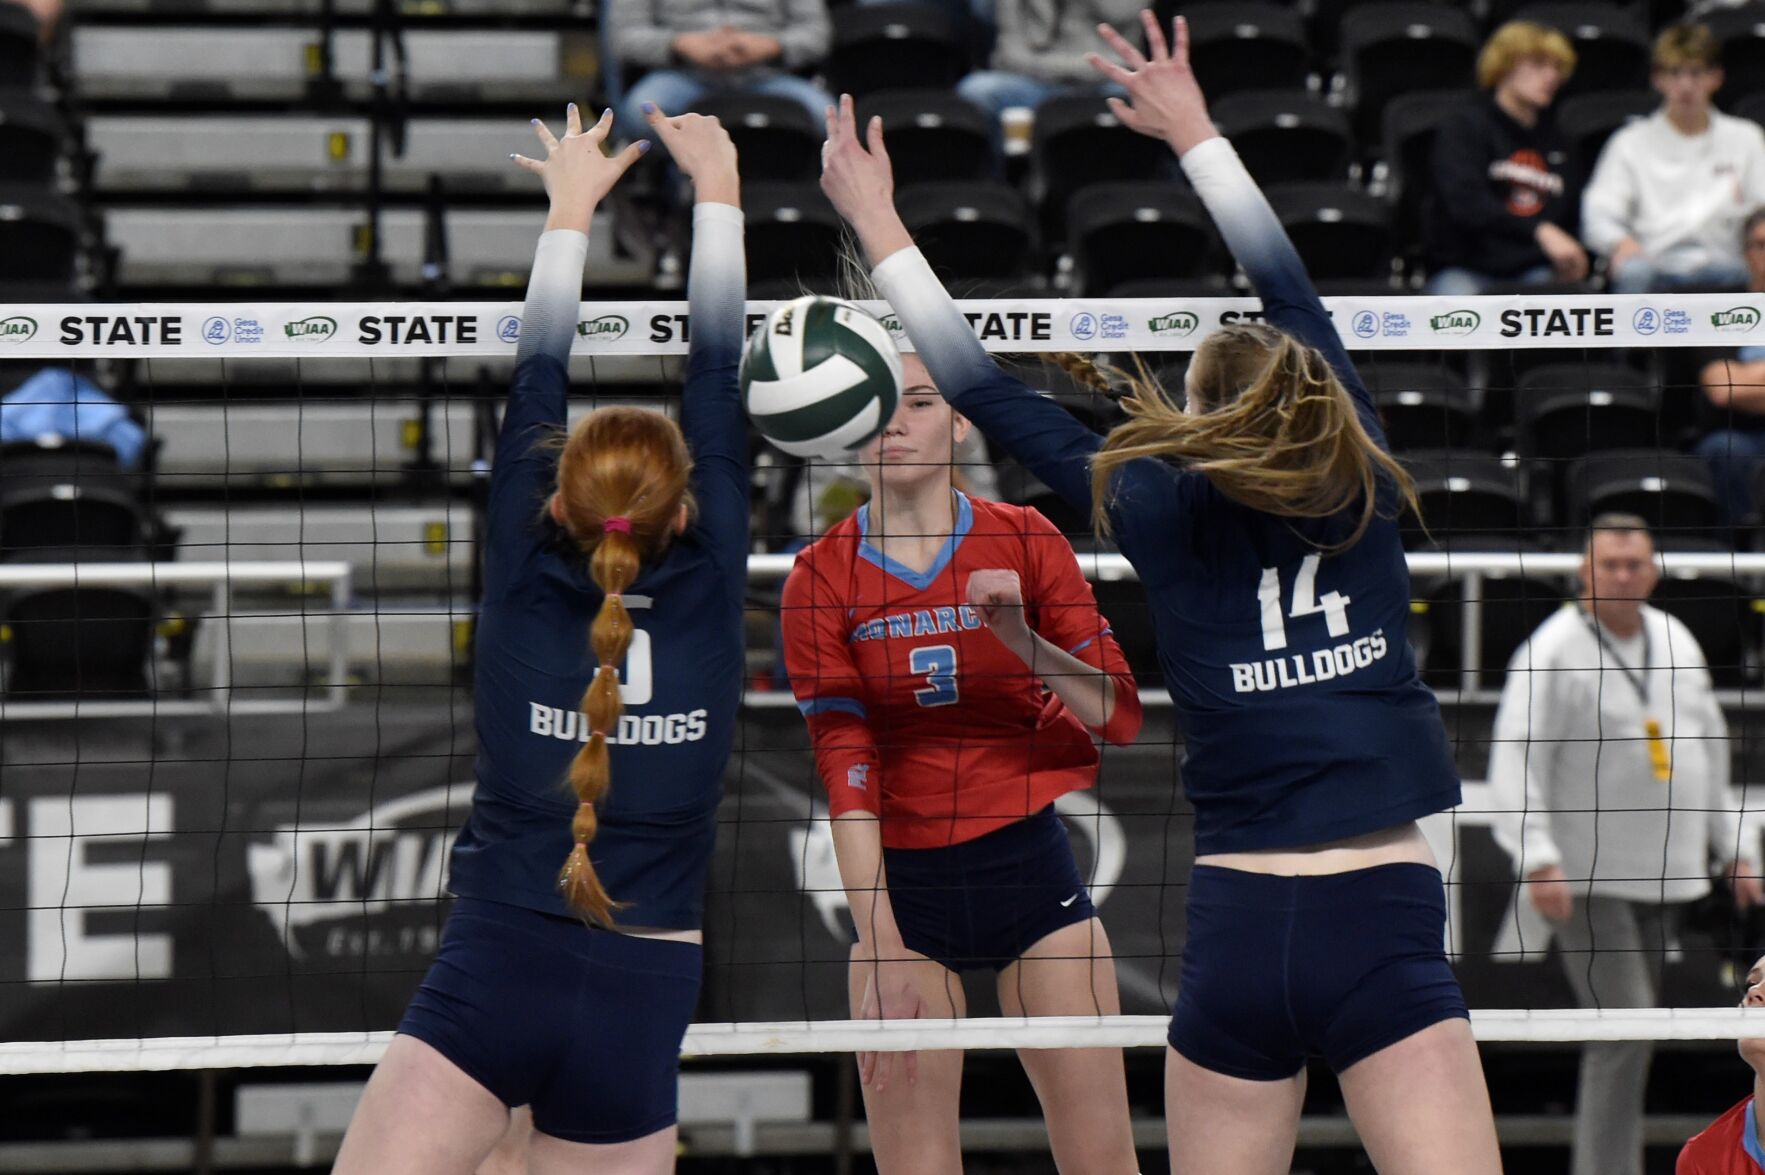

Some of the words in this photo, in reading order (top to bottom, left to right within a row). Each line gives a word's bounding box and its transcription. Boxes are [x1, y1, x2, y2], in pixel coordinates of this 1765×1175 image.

[1155, 318, 1192, 330] WIAA
[1382, 320, 1412, 329] Credit
[1436, 316, 1473, 328] WIAA
[1500, 308, 1615, 337] STATE
[1663, 317, 1693, 326] Credit
[1717, 312, 1754, 325] WIAA
[60, 316, 182, 345] STATE
[234, 326, 265, 335] Credit
[293, 322, 329, 335] WIAA
[358, 316, 478, 345] STATE
[584, 321, 622, 334] WIAA
[963, 312, 1052, 340] ATE
[1100, 321, 1129, 330] Credit
[1257, 552, 1351, 651] 14
[850, 602, 988, 641] ONARC
[1229, 628, 1388, 693] BULLDOGS
[909, 644, 960, 708] 3
